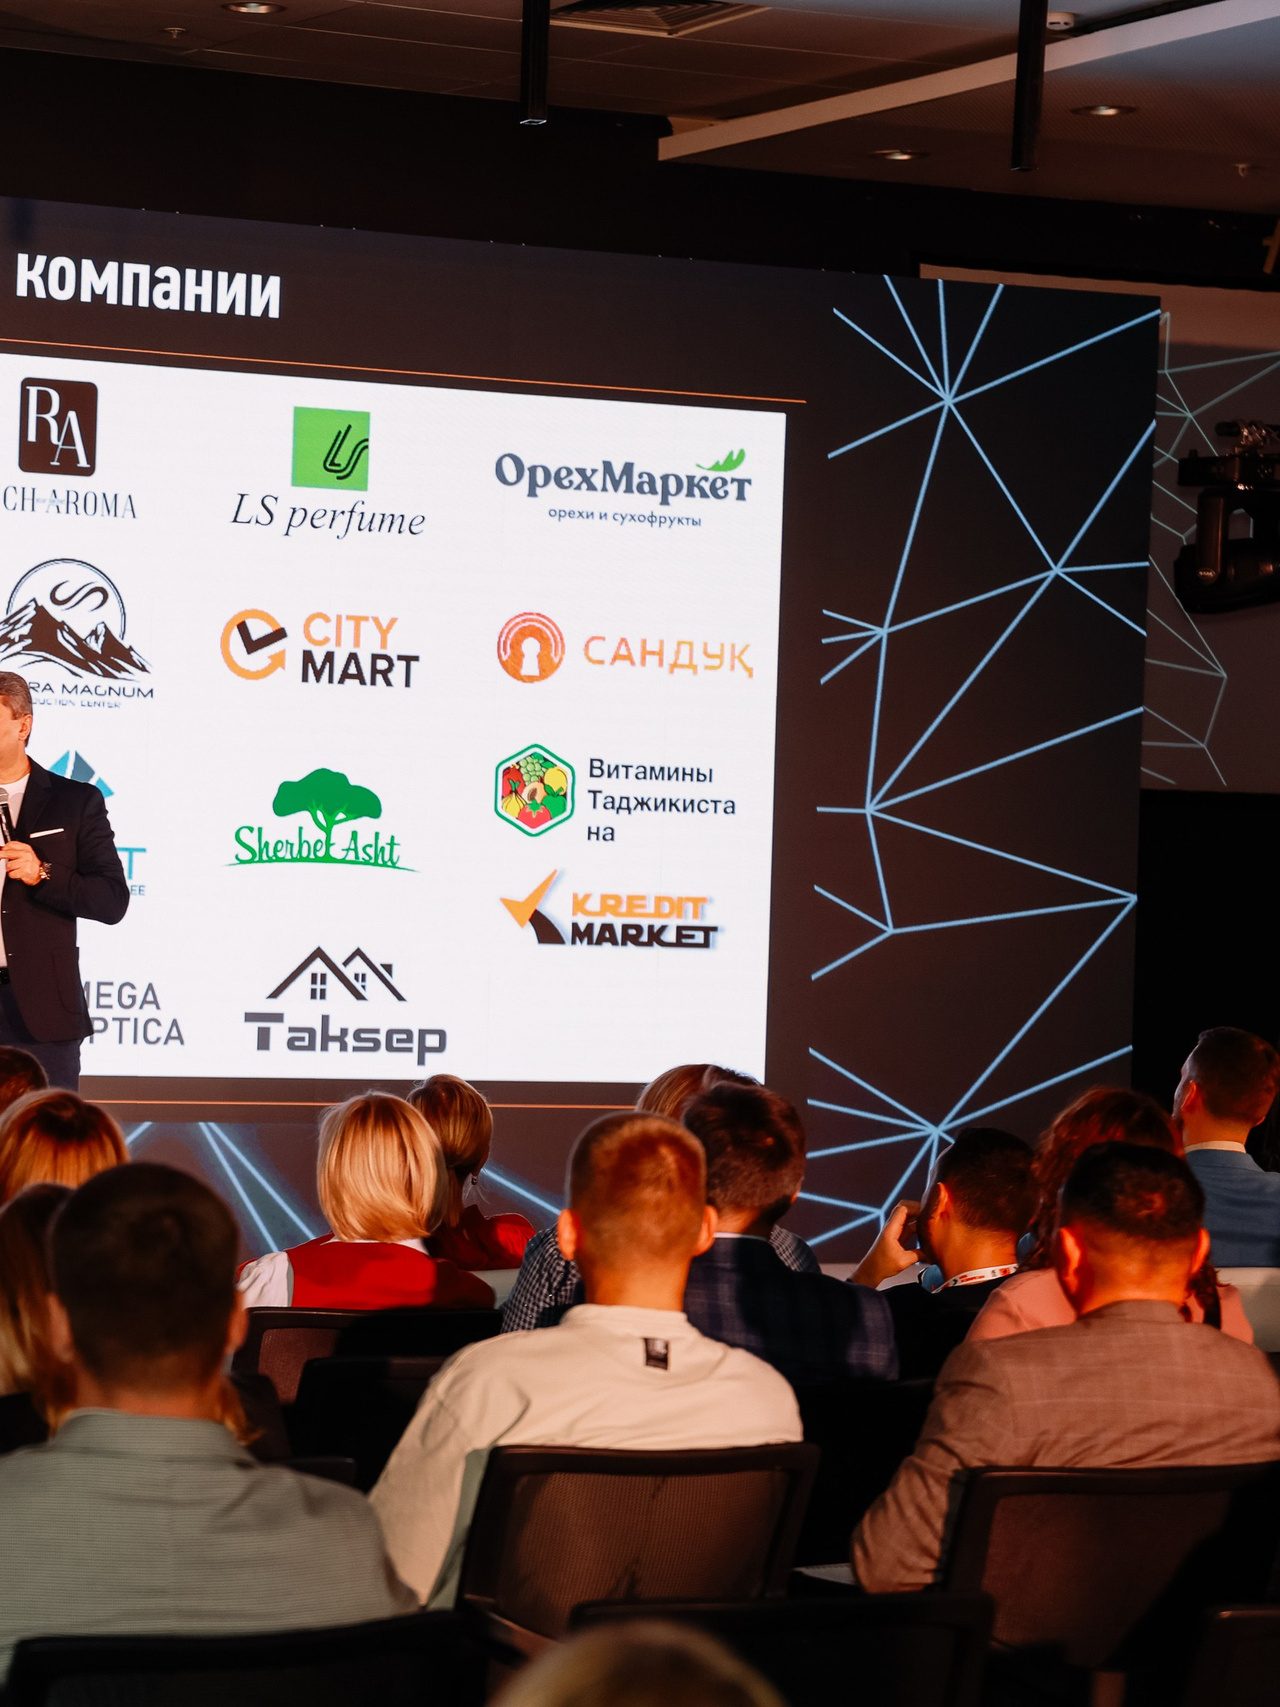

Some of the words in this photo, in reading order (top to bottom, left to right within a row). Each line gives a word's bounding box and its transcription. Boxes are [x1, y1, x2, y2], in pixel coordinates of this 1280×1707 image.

[16, 252, 281, 319] компании
[495, 453, 752, 506] ОрехМаркет
[45, 488, 137, 519] AROMA
[230, 493, 279, 526] LS
[283, 500, 426, 540] perfume
[548, 508, 595, 522] орехи
[599, 511, 608, 521] и
[612, 511, 702, 528] сухофрукты
[303, 612, 399, 650] CITY
[301, 649, 420, 688] MART
[28, 681, 55, 694] RA
[62, 683, 154, 698] MAGNUM
[588, 758, 713, 783] Витамины
[587, 790, 736, 815] Таджикиста
[341, 830, 401, 866] Asht
[587, 825, 615, 841] на
[572, 892, 708, 919] KREDIT
[571, 922, 718, 948] MARKET
[89, 1017, 185, 1046] PTICA
[244, 1012, 447, 1066] Taksep
